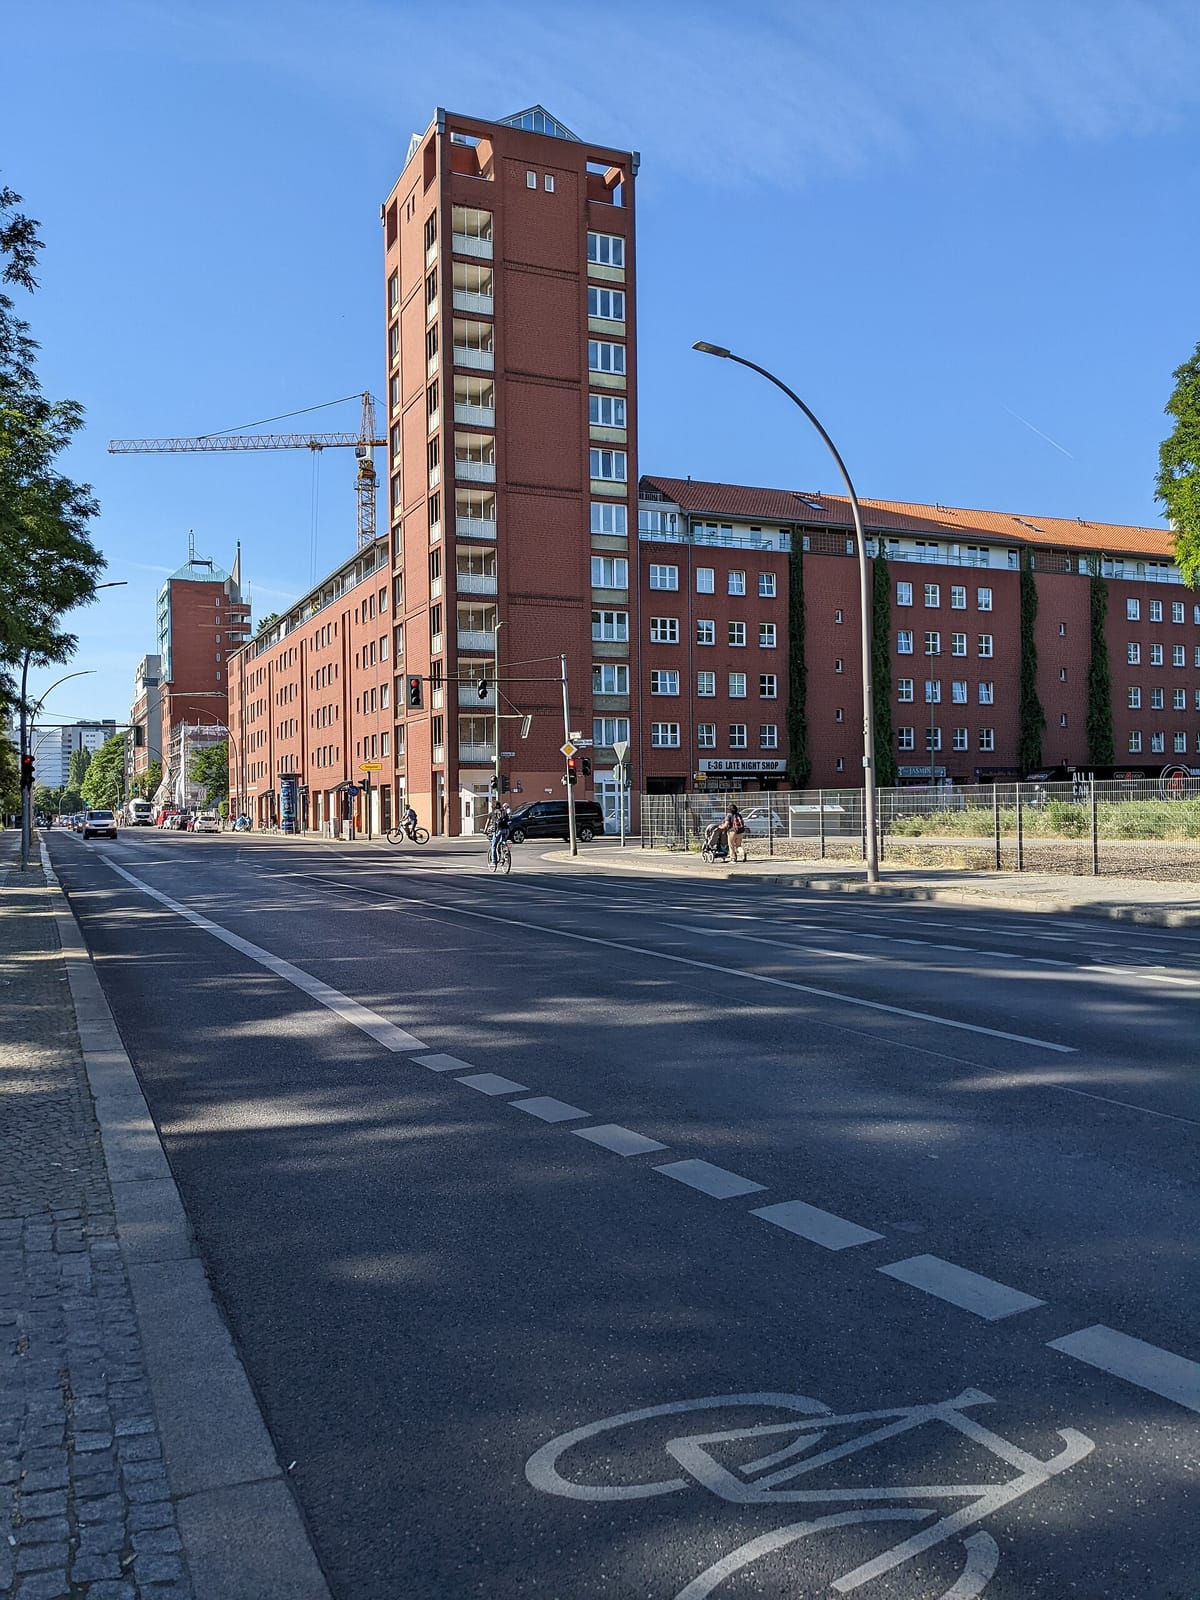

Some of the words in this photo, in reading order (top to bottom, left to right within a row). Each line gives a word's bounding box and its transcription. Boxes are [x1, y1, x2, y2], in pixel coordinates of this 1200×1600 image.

[707, 761, 723, 770] E-36
[725, 761, 740, 770] LATE
[741, 761, 760, 770] NIGHT
[761, 761, 779, 770] SHOP
